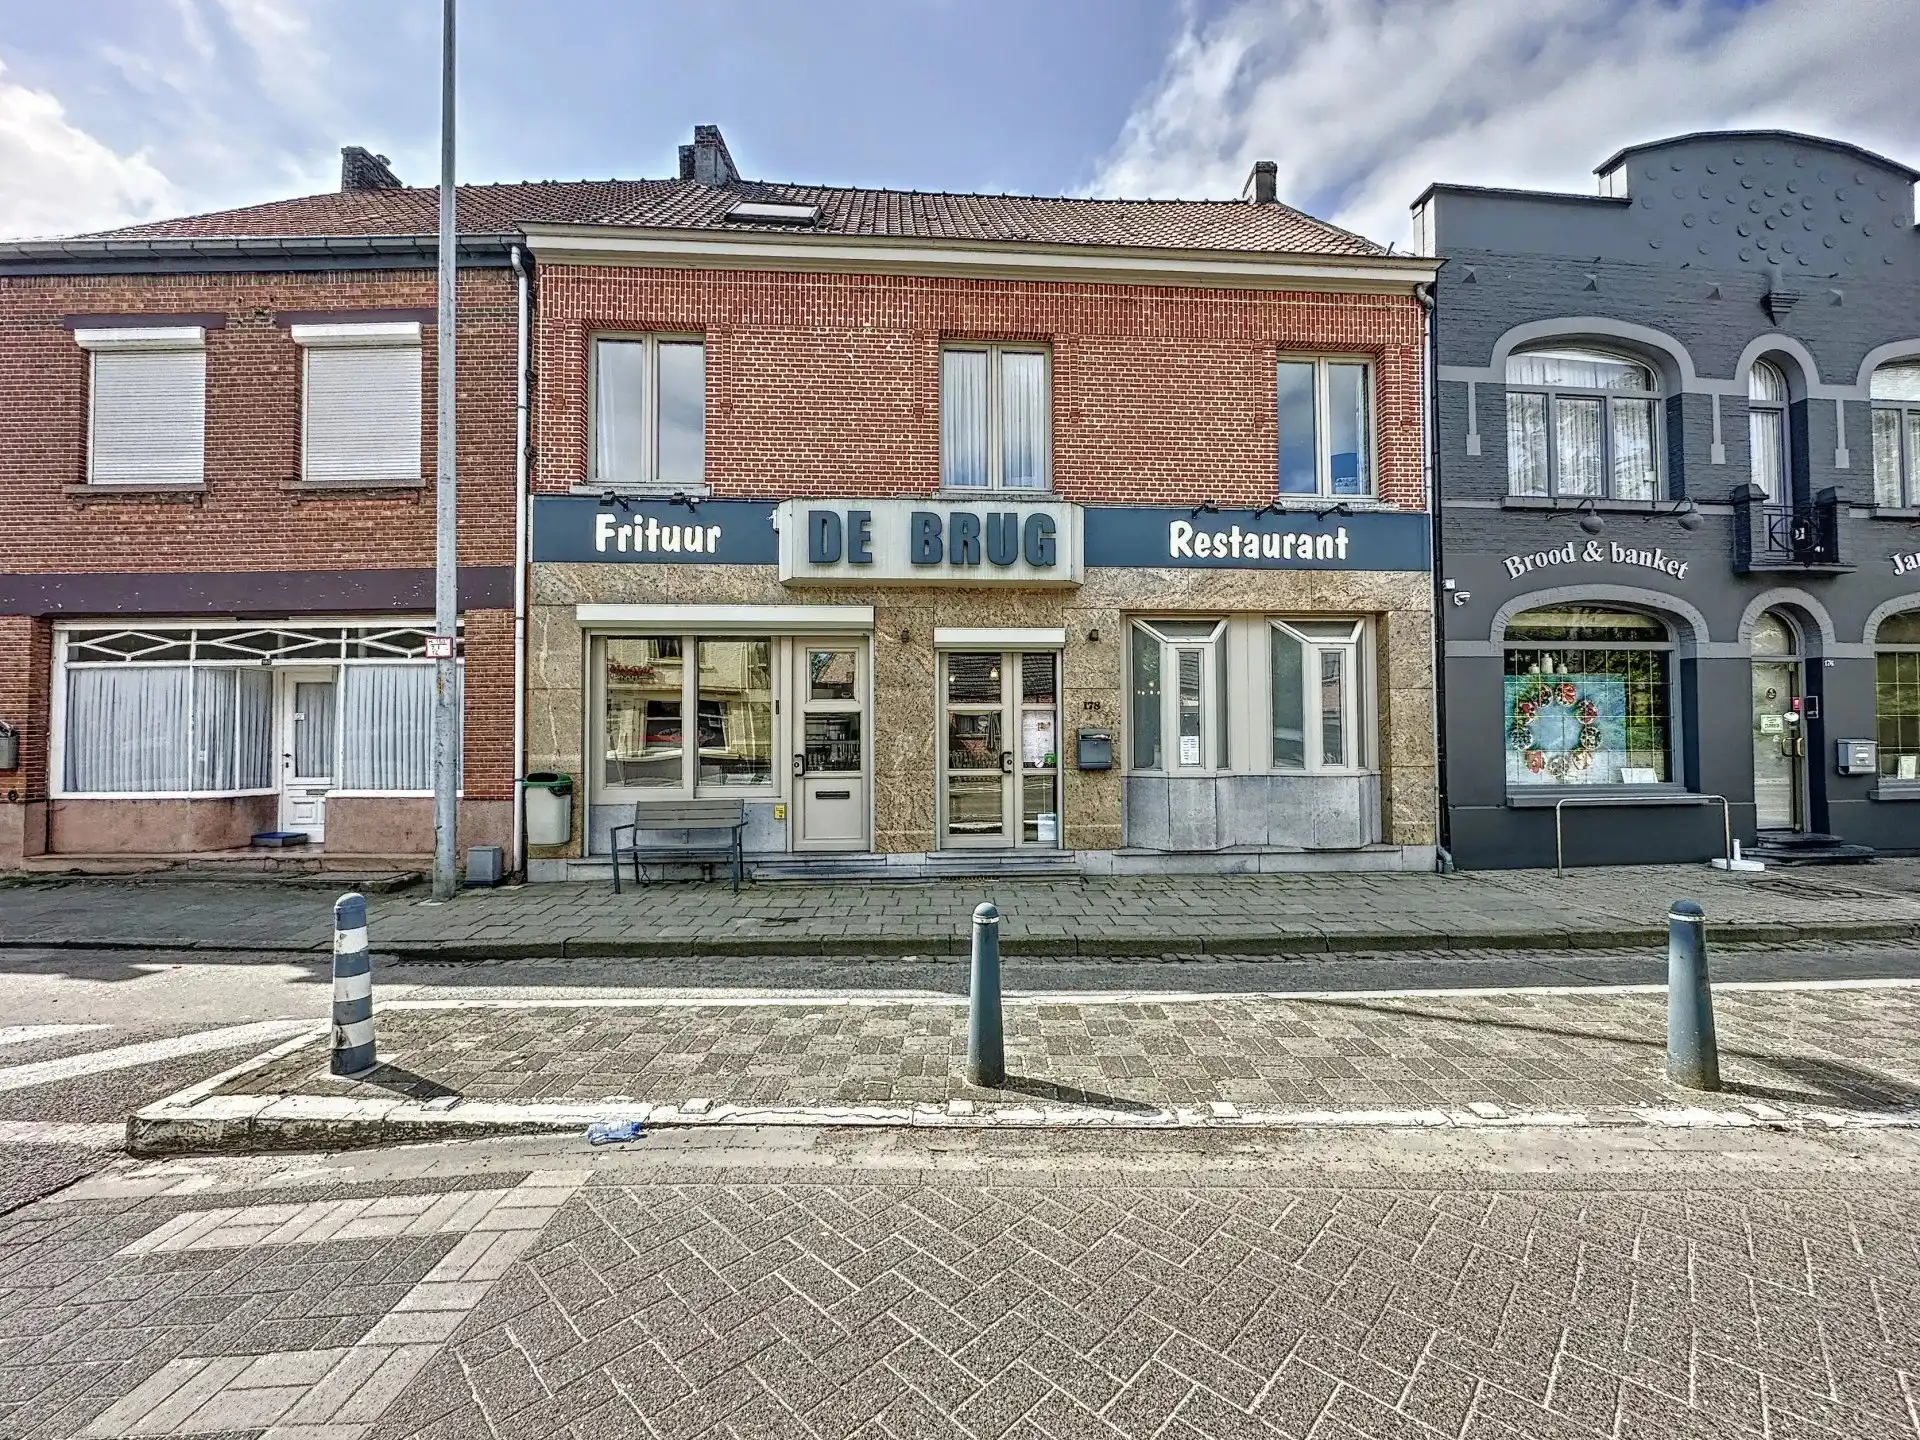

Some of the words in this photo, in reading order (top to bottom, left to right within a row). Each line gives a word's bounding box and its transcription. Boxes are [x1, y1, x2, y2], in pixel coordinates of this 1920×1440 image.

[594, 513, 722, 554] Frituur
[808, 510, 872, 564] DE
[911, 511, 1057, 567] BRUG
[1169, 519, 1349, 560] Restaurant
[1502, 541, 1577, 580] Brood
[1581, 540, 1605, 563] &
[1610, 541, 1689, 580] banket
[1083, 701, 1101, 710] 178
